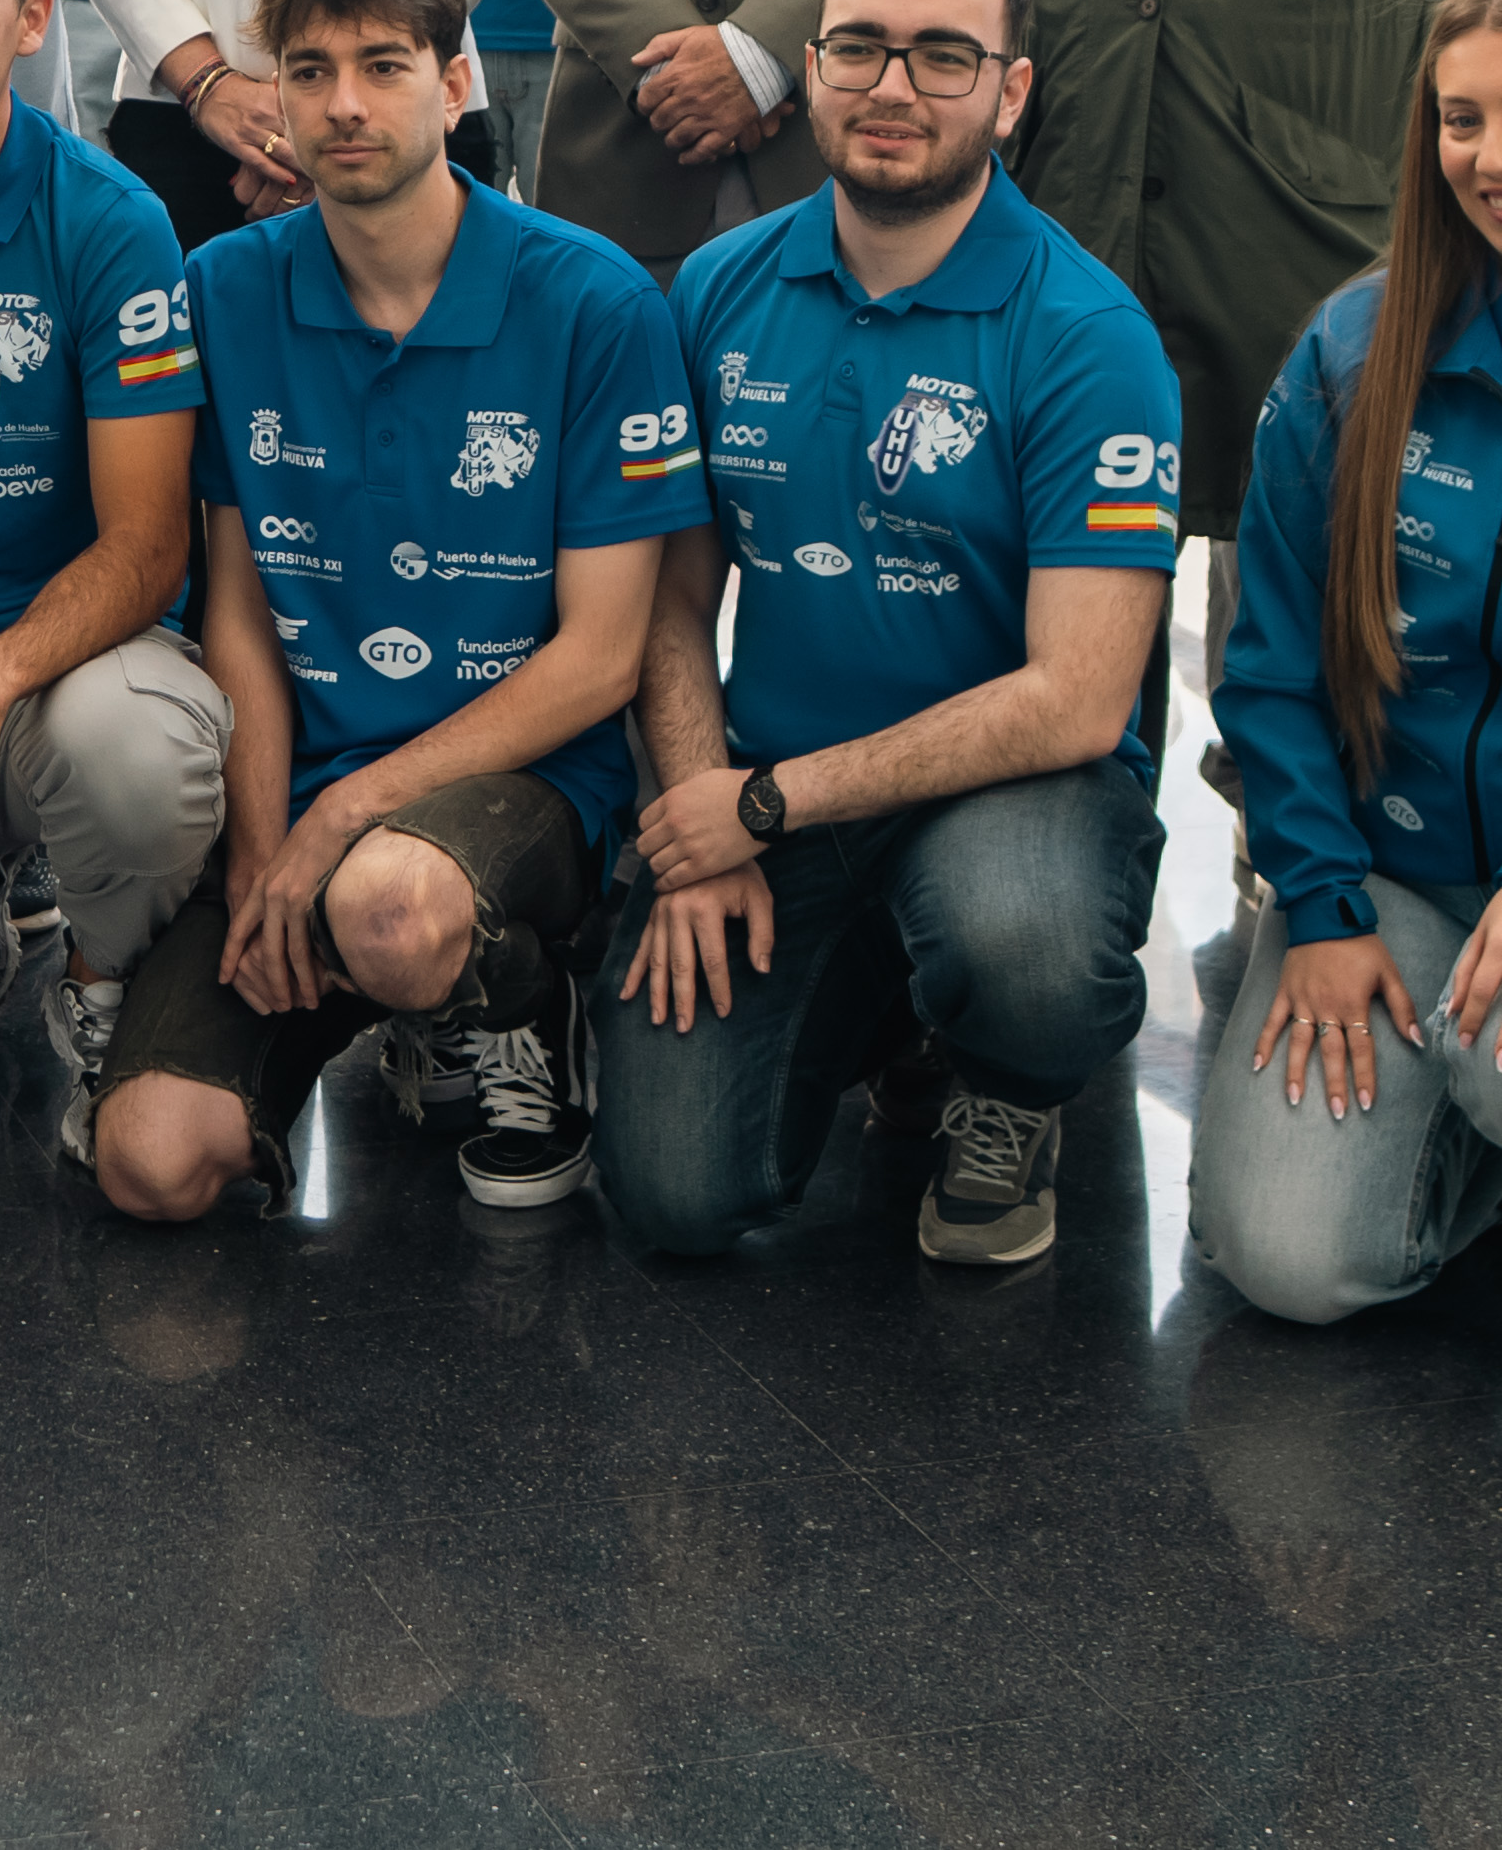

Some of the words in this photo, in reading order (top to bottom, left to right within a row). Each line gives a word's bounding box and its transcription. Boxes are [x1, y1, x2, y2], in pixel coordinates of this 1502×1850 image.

[118, 279, 191, 347] 93
[739, 387, 787, 403] HUELVA
[906, 373, 970, 399] MOTO
[4, 423, 16, 433] de
[18, 423, 50, 433] Huelva
[466, 410, 521, 425] MOTO
[619, 404, 688, 452] 93
[881, 408, 915, 475] UHU
[282, 450, 325, 469] HUELVA
[768, 460, 787, 472] XXI
[1094, 433, 1180, 495] 93
[1421, 467, 1474, 491] HUELVA
[906, 517, 918, 527] de
[254, 551, 320, 569] IVERSITAS
[323, 558, 342, 572] XXI
[436, 550, 477, 563] Puerto
[480, 551, 495, 564] de
[498, 553, 537, 567] Huelva
[801, 550, 844, 568] GTO
[877, 573, 960, 596] moeve
[368, 641, 422, 664] GTO
[457, 636, 535, 655] fundación
[1387, 800, 1417, 826] GTO
